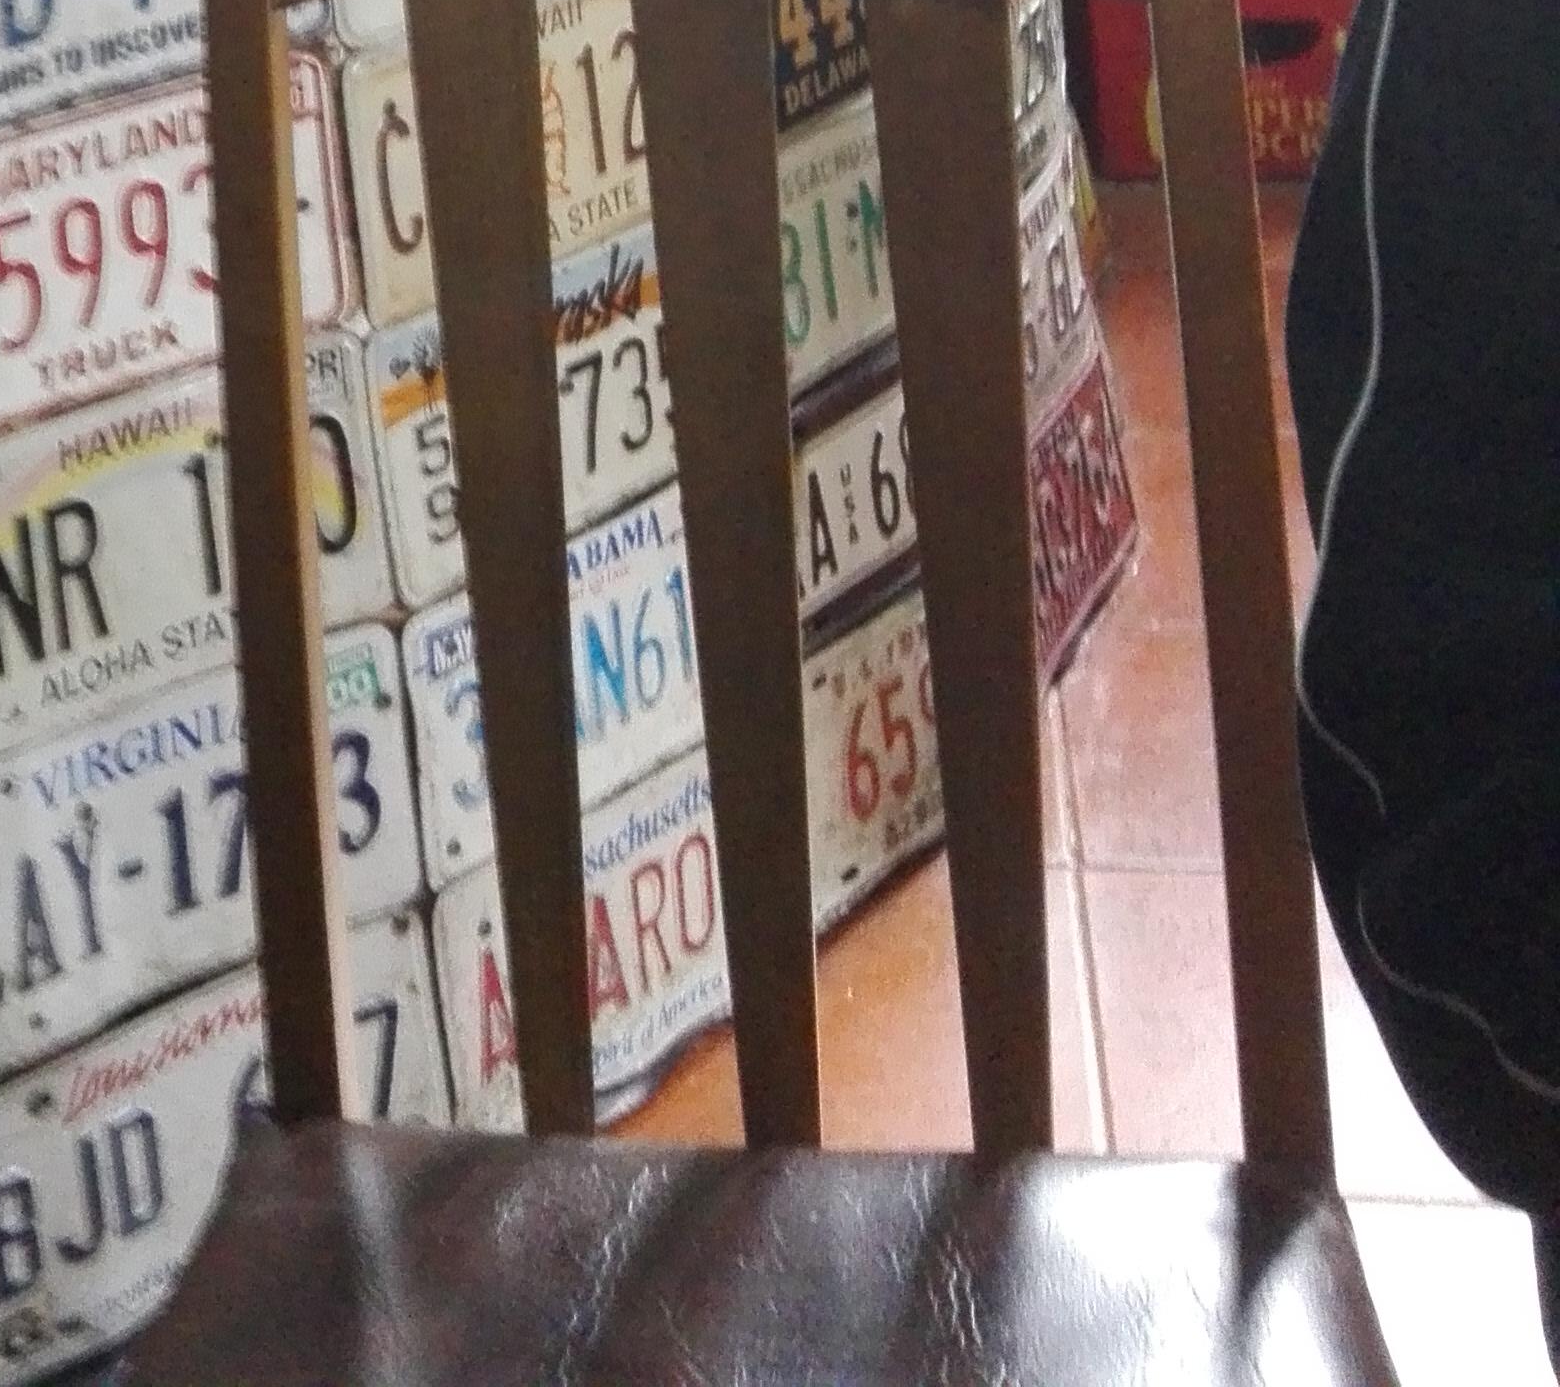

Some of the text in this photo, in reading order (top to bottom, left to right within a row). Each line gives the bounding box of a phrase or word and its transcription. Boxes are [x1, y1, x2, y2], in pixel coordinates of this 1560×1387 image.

[54, 45, 85, 76] TO
[90, 16, 204, 67] DISCOVE
[783, 43, 872, 115] DELAWA
[567, 183, 636, 235] STATE
[37, 323, 179, 382] TRUCK
[56, 398, 195, 468] HAWAII
[567, 506, 664, 581] ABAMA
[40, 607, 242, 706] ALOHA STA
[586, 773, 713, 876] sachusetts
